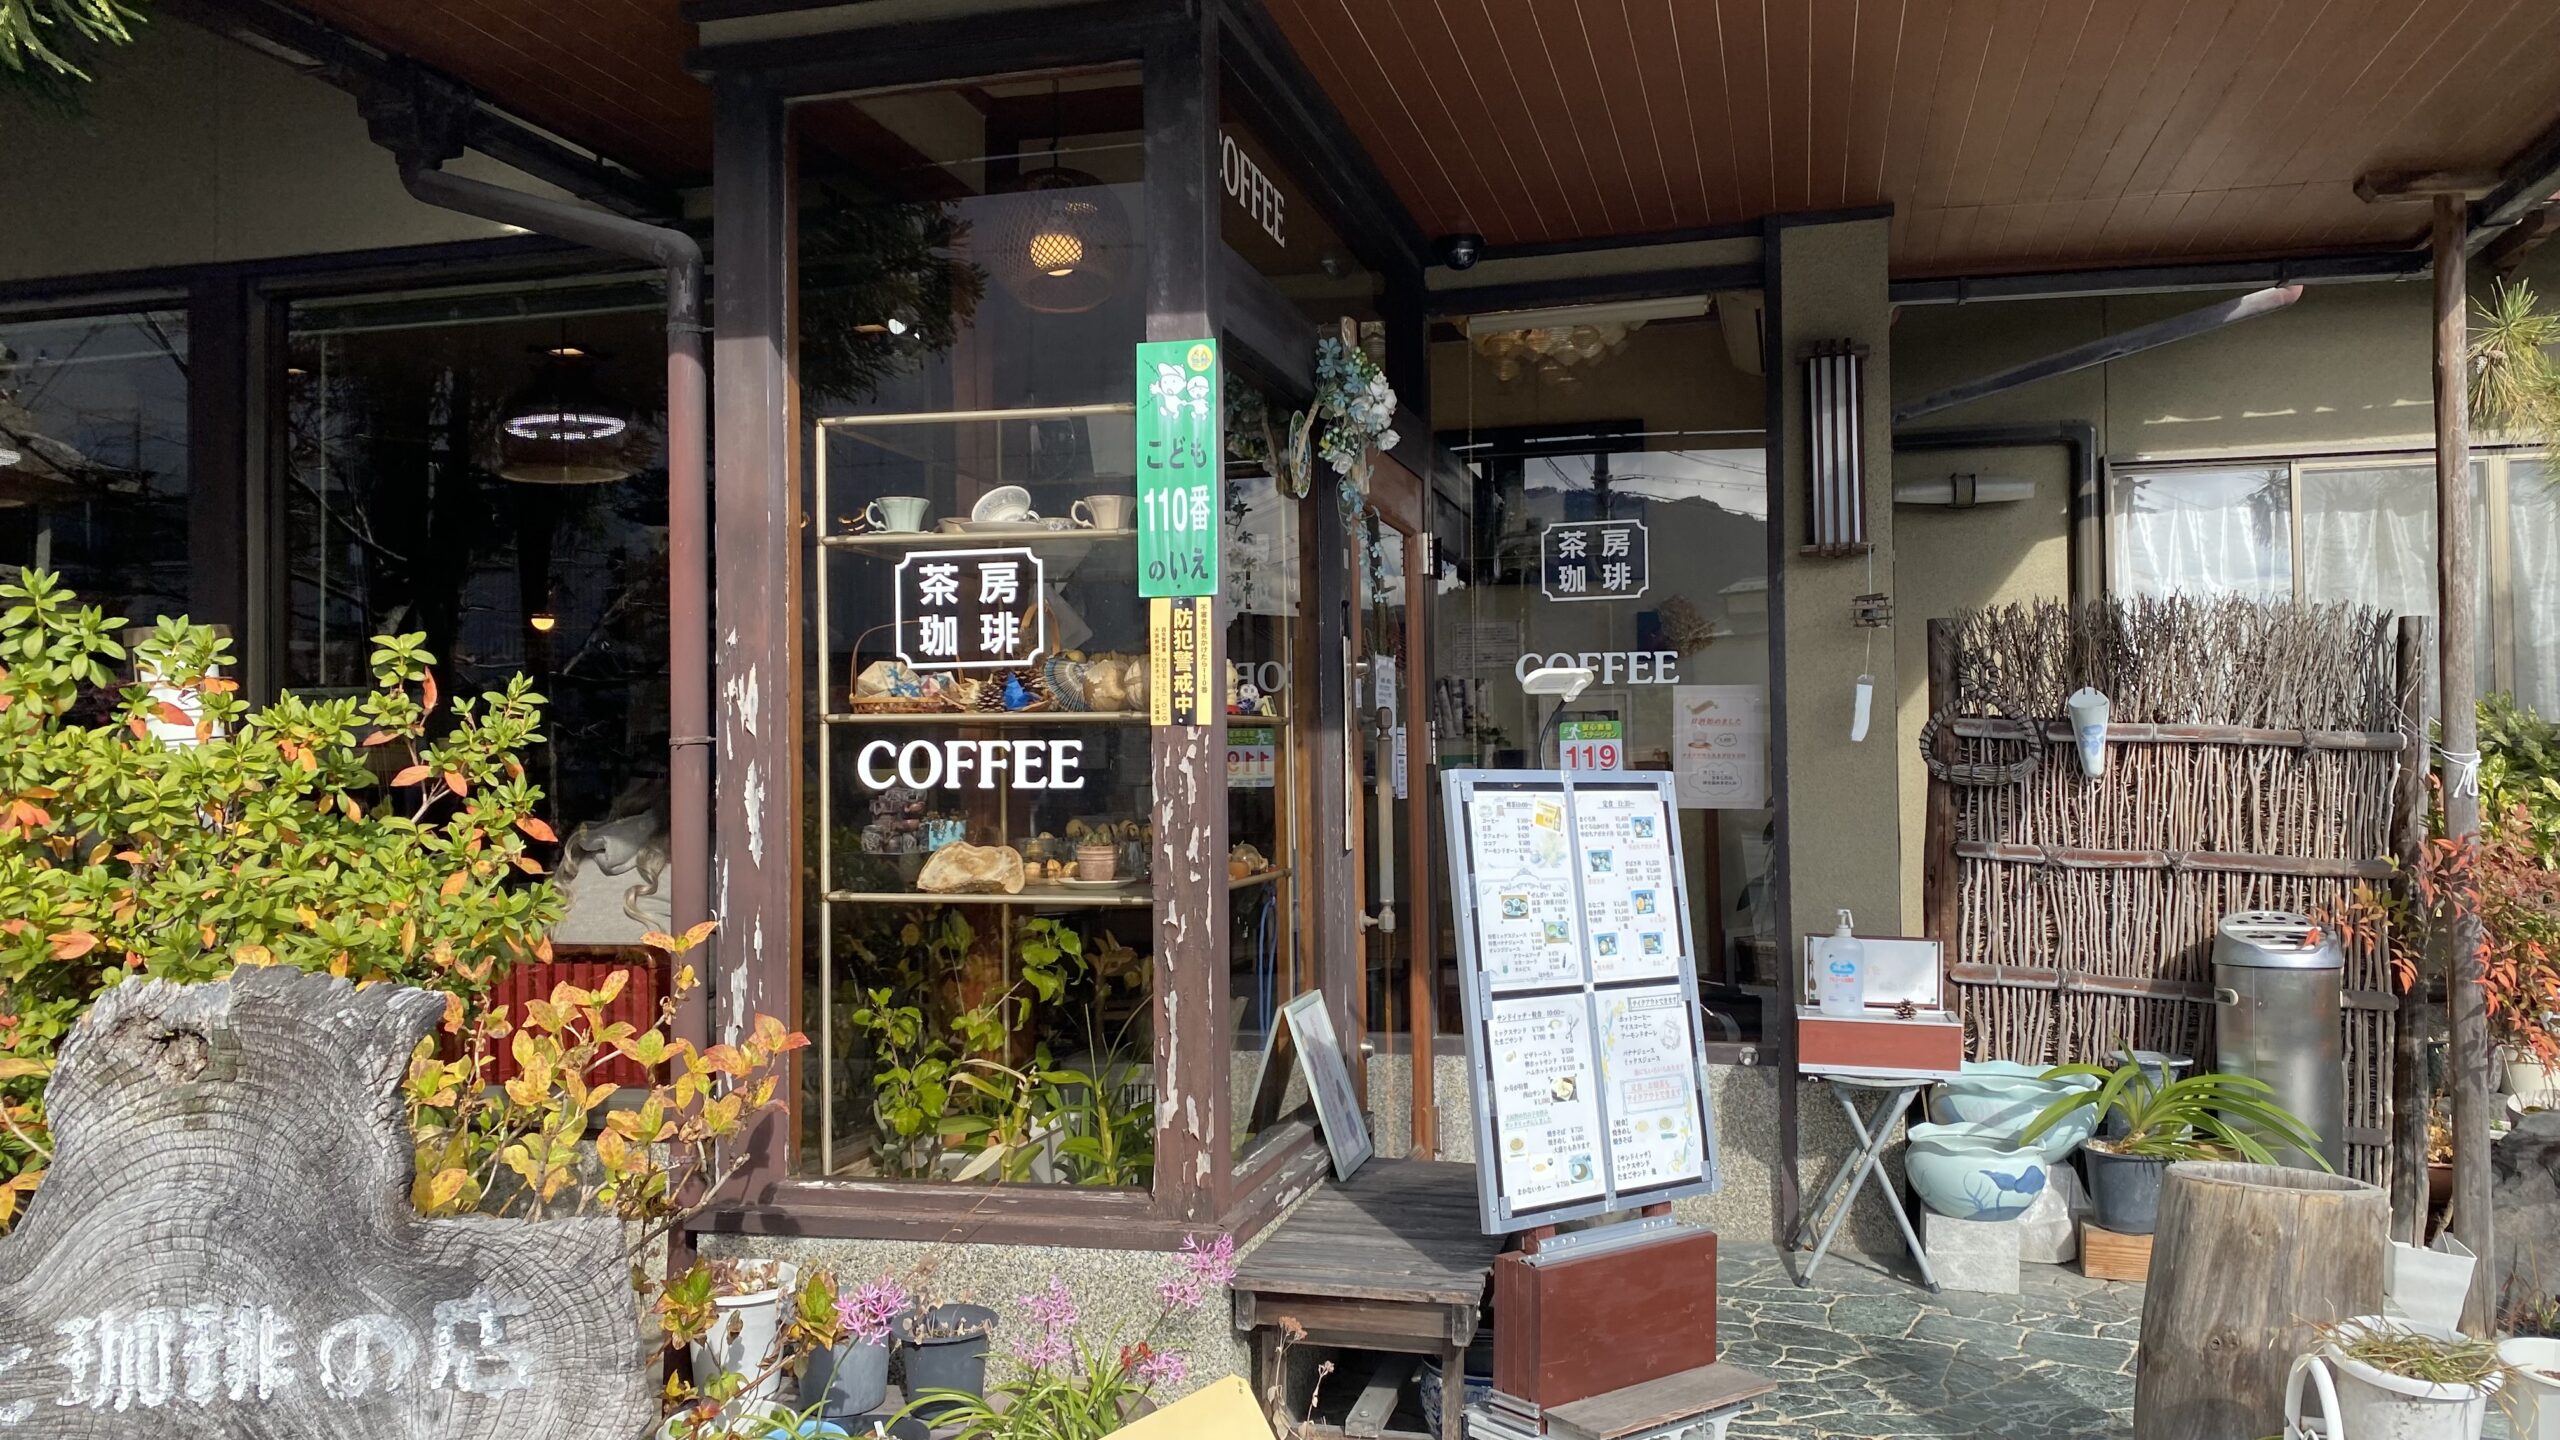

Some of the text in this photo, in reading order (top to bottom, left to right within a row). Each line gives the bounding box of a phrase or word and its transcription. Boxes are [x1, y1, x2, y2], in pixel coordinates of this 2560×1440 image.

[1219, 128, 1285, 248] OFFEE
[1146, 436, 1207, 470] こども
[1143, 486, 1211, 533] 110番
[1558, 529, 1631, 559] 茶房
[1148, 547, 1209, 582] のいえ
[1558, 562, 1632, 592] 珈琲
[919, 561, 1020, 606] 茶房
[919, 613, 1021, 657] 珈琲
[1173, 607, 1194, 715] 防犯警戒中
[1565, 745, 1618, 769] 119
[857, 739, 1085, 790] COFFEE
[1618, 1014, 1651, 1023] ホットコーヒー
[1495, 1027, 1526, 1037] ミックスサンド
[1620, 1023, 1652, 1031] アイスコーヒー
[1494, 1036, 1522, 1046] たまごサンド
[1621, 1030, 1658, 1040] アーモンドオーレ
[1524, 1050, 1551, 1059] ピザトースト
[1623, 1047, 1656, 1057] バナナジュース
[1624, 1055, 1661, 1066] ミックスジュース
[1546, 1128, 1566, 1138] 焼きそば
[1612, 1128, 1632, 1137] 焼きめし
[1612, 1136, 1633, 1146] 焼きそば
[1617, 1160, 1650, 1172] ミックスサンド
[1617, 1169, 1647, 1181] たまごサンド
[1517, 1185, 1552, 1196] まかないカレー
